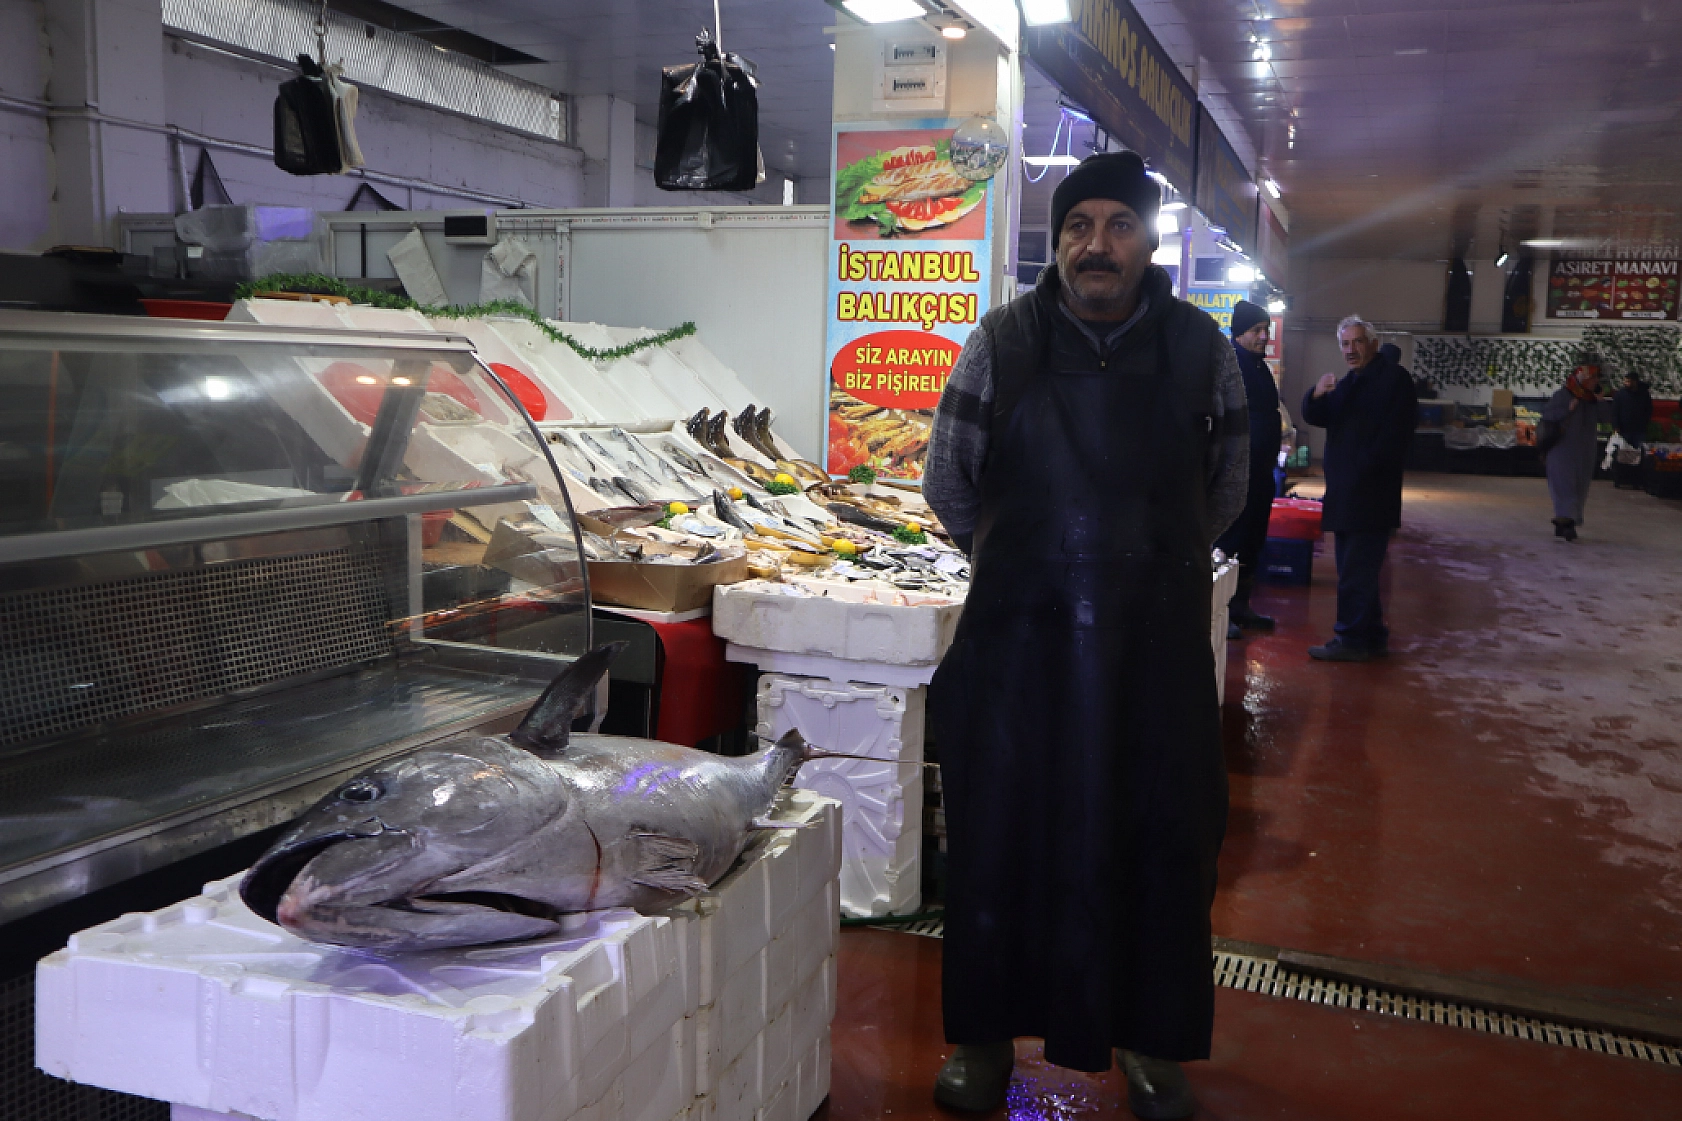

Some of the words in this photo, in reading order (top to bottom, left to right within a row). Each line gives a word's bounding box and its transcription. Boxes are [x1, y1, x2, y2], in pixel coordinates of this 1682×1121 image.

[838, 243, 979, 281] İSTANBUL
[1614, 260, 1677, 274] MANAVI
[837, 291, 978, 331] BALIKÇISI
[856, 343, 881, 364] SİZ
[885, 347, 952, 367] ARAYIN
[845, 369, 872, 390] BİZ
[876, 369, 949, 396] PİŞİRELİ
